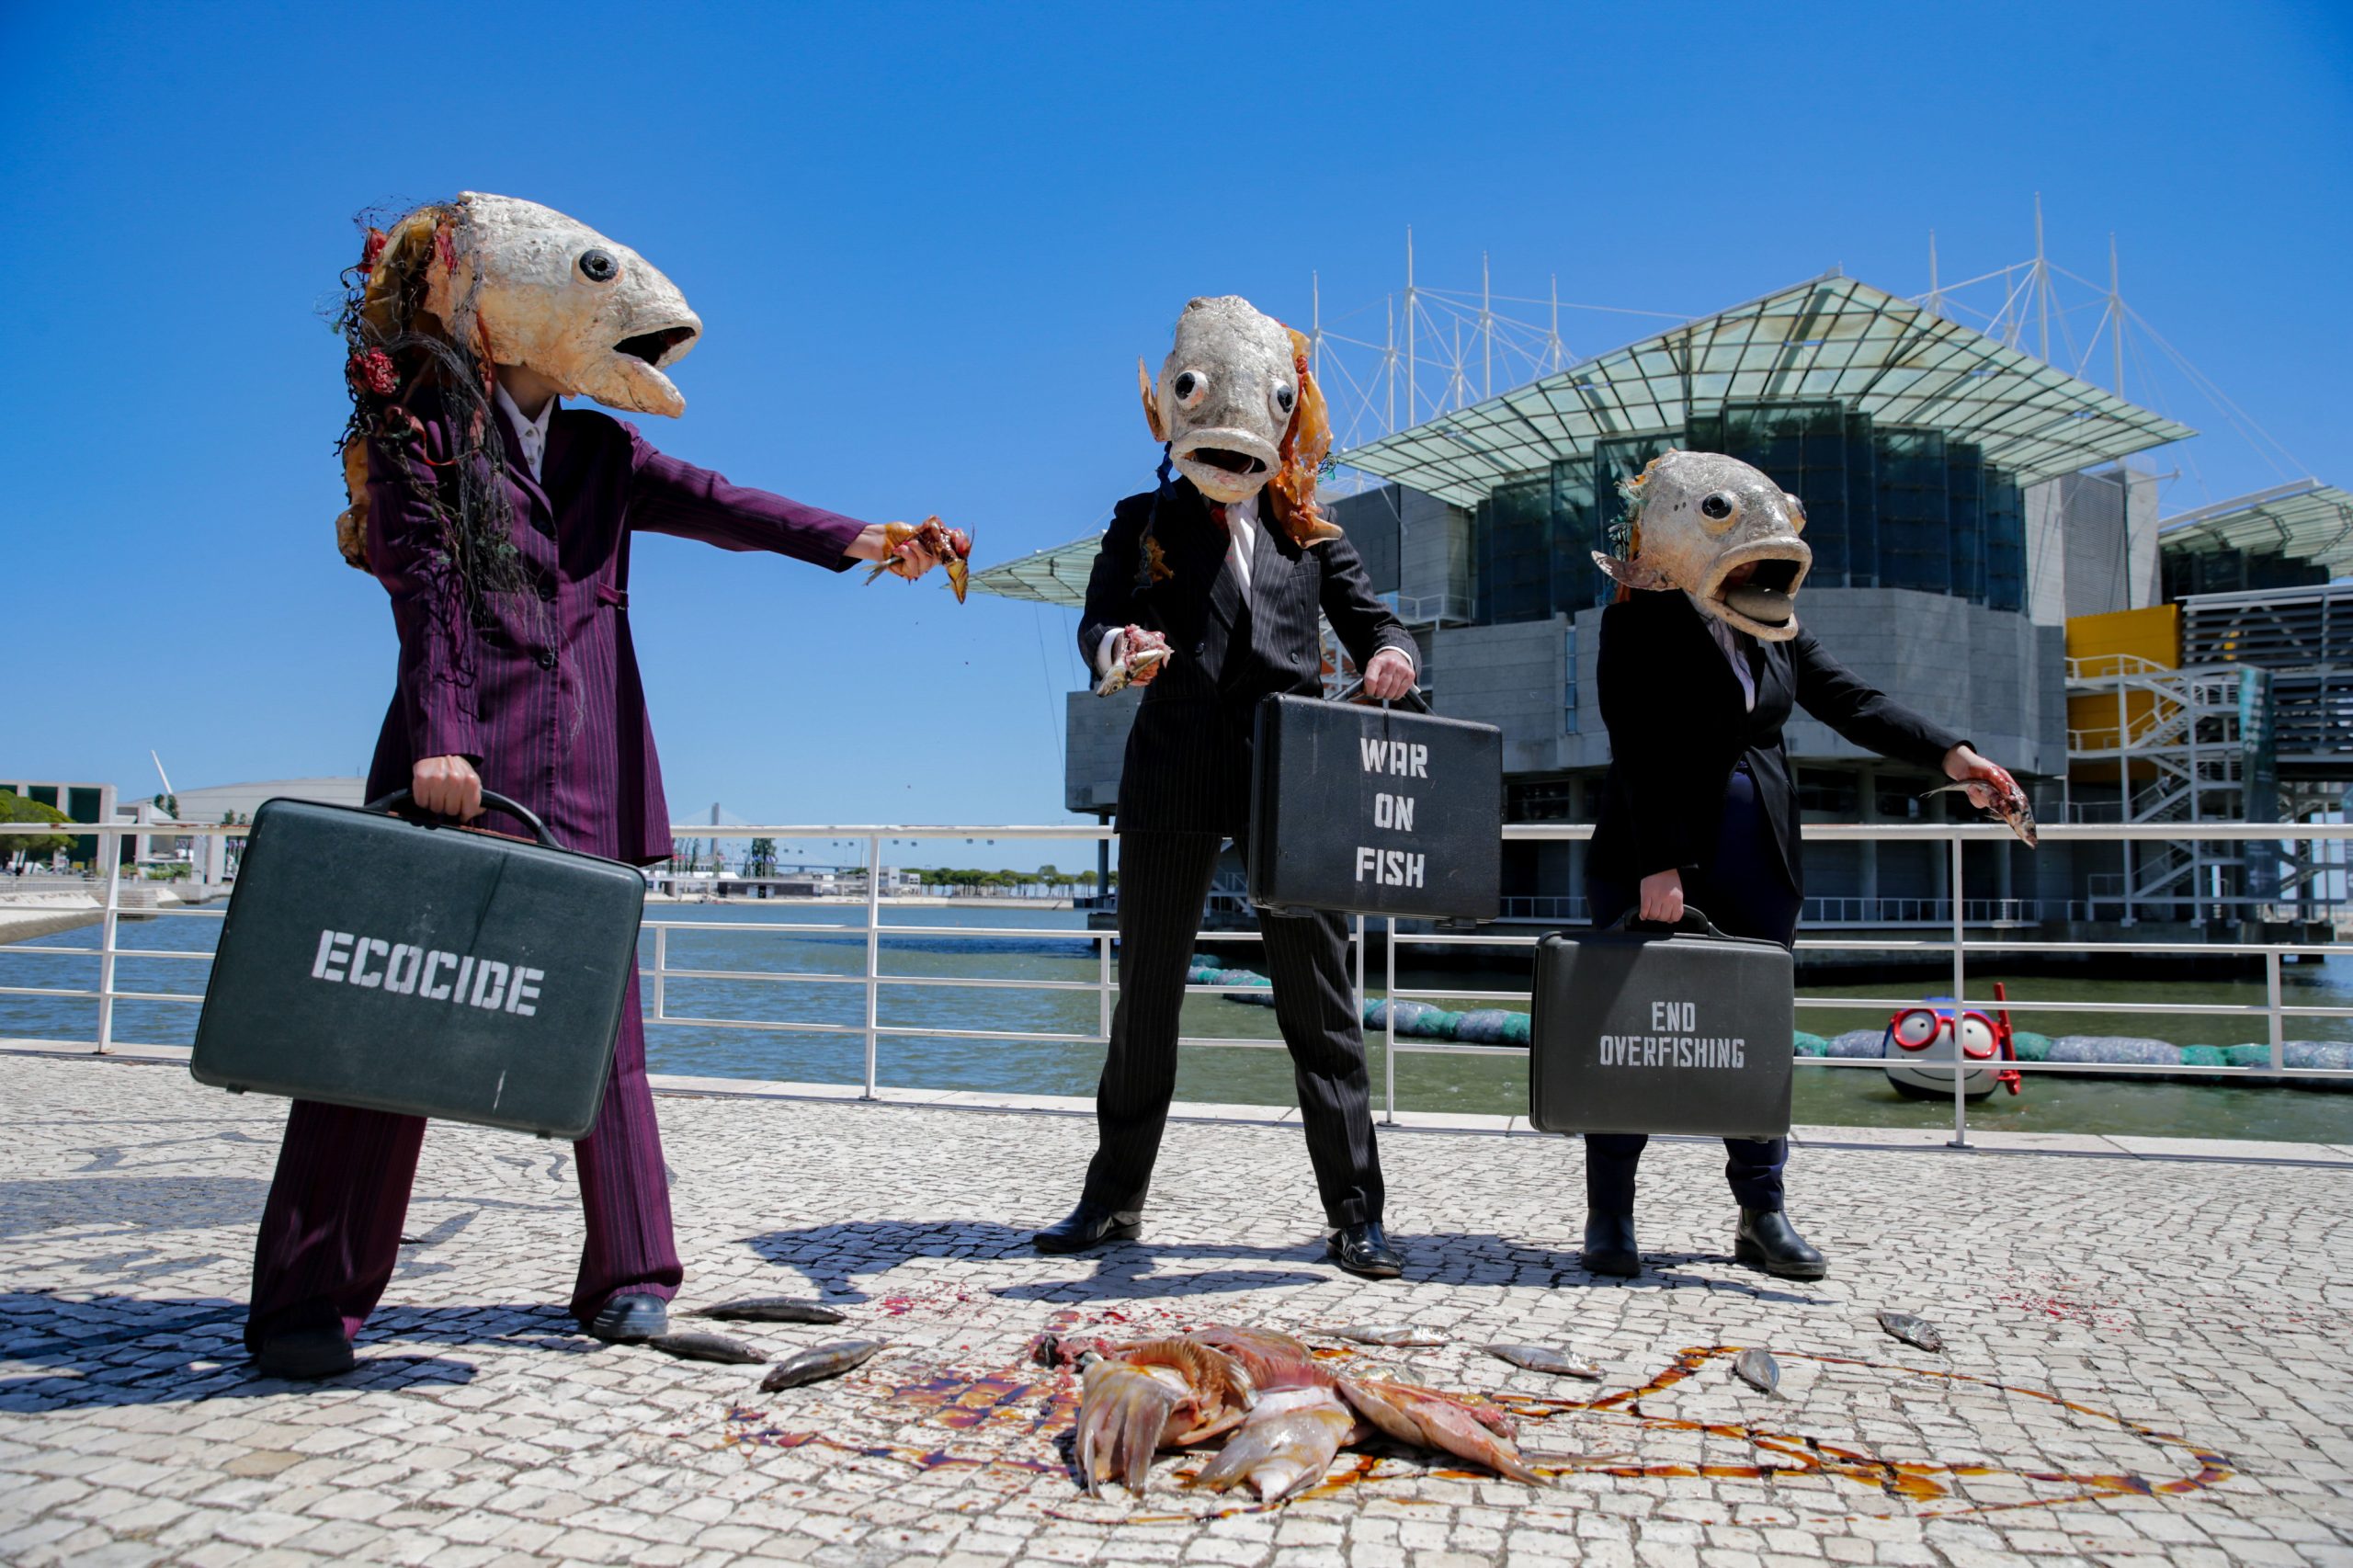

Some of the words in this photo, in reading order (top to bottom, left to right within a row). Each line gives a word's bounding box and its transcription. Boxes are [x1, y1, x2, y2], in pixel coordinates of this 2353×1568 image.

[1360, 737, 1428, 778] WAR
[1374, 792, 1415, 832] ON
[1356, 846, 1425, 889] FISH
[311, 928, 546, 1017] ECOCIDE
[1652, 1001, 1696, 1032] END
[1599, 1035, 1745, 1068] OVERFISHING
